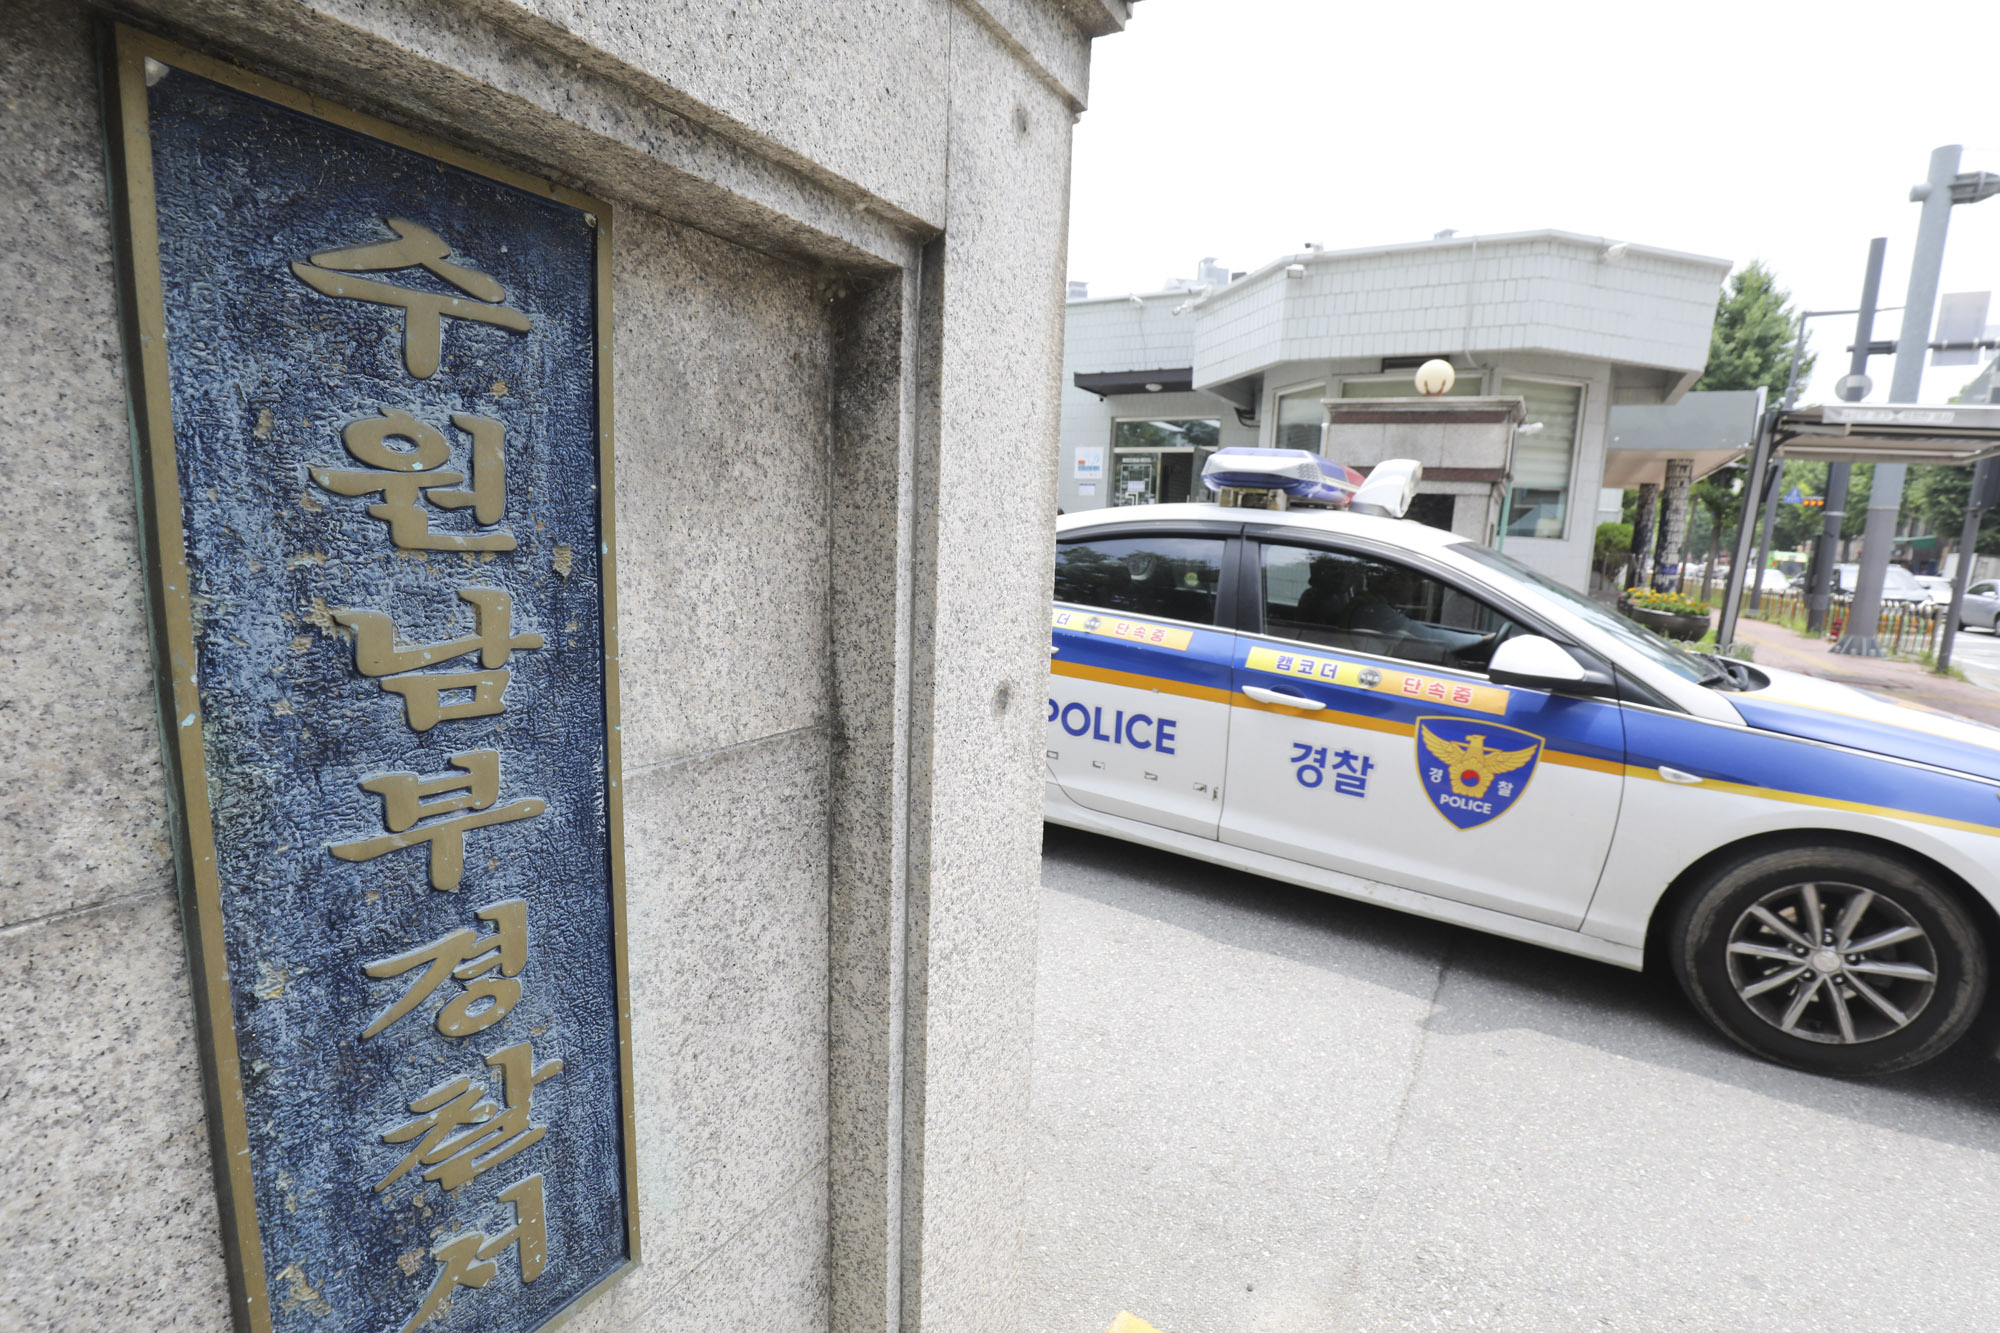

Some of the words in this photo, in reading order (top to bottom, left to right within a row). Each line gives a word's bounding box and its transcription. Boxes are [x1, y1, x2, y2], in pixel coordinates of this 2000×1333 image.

[1115, 622, 1166, 643] 단속중
[1276, 655, 1338, 680] 캠코더
[1402, 677, 1472, 704] 단속중
[291, 217, 562, 1333] 수원남부경찰서
[1290, 742, 1374, 798] 경찰
[1440, 794, 1492, 815] POLICE
